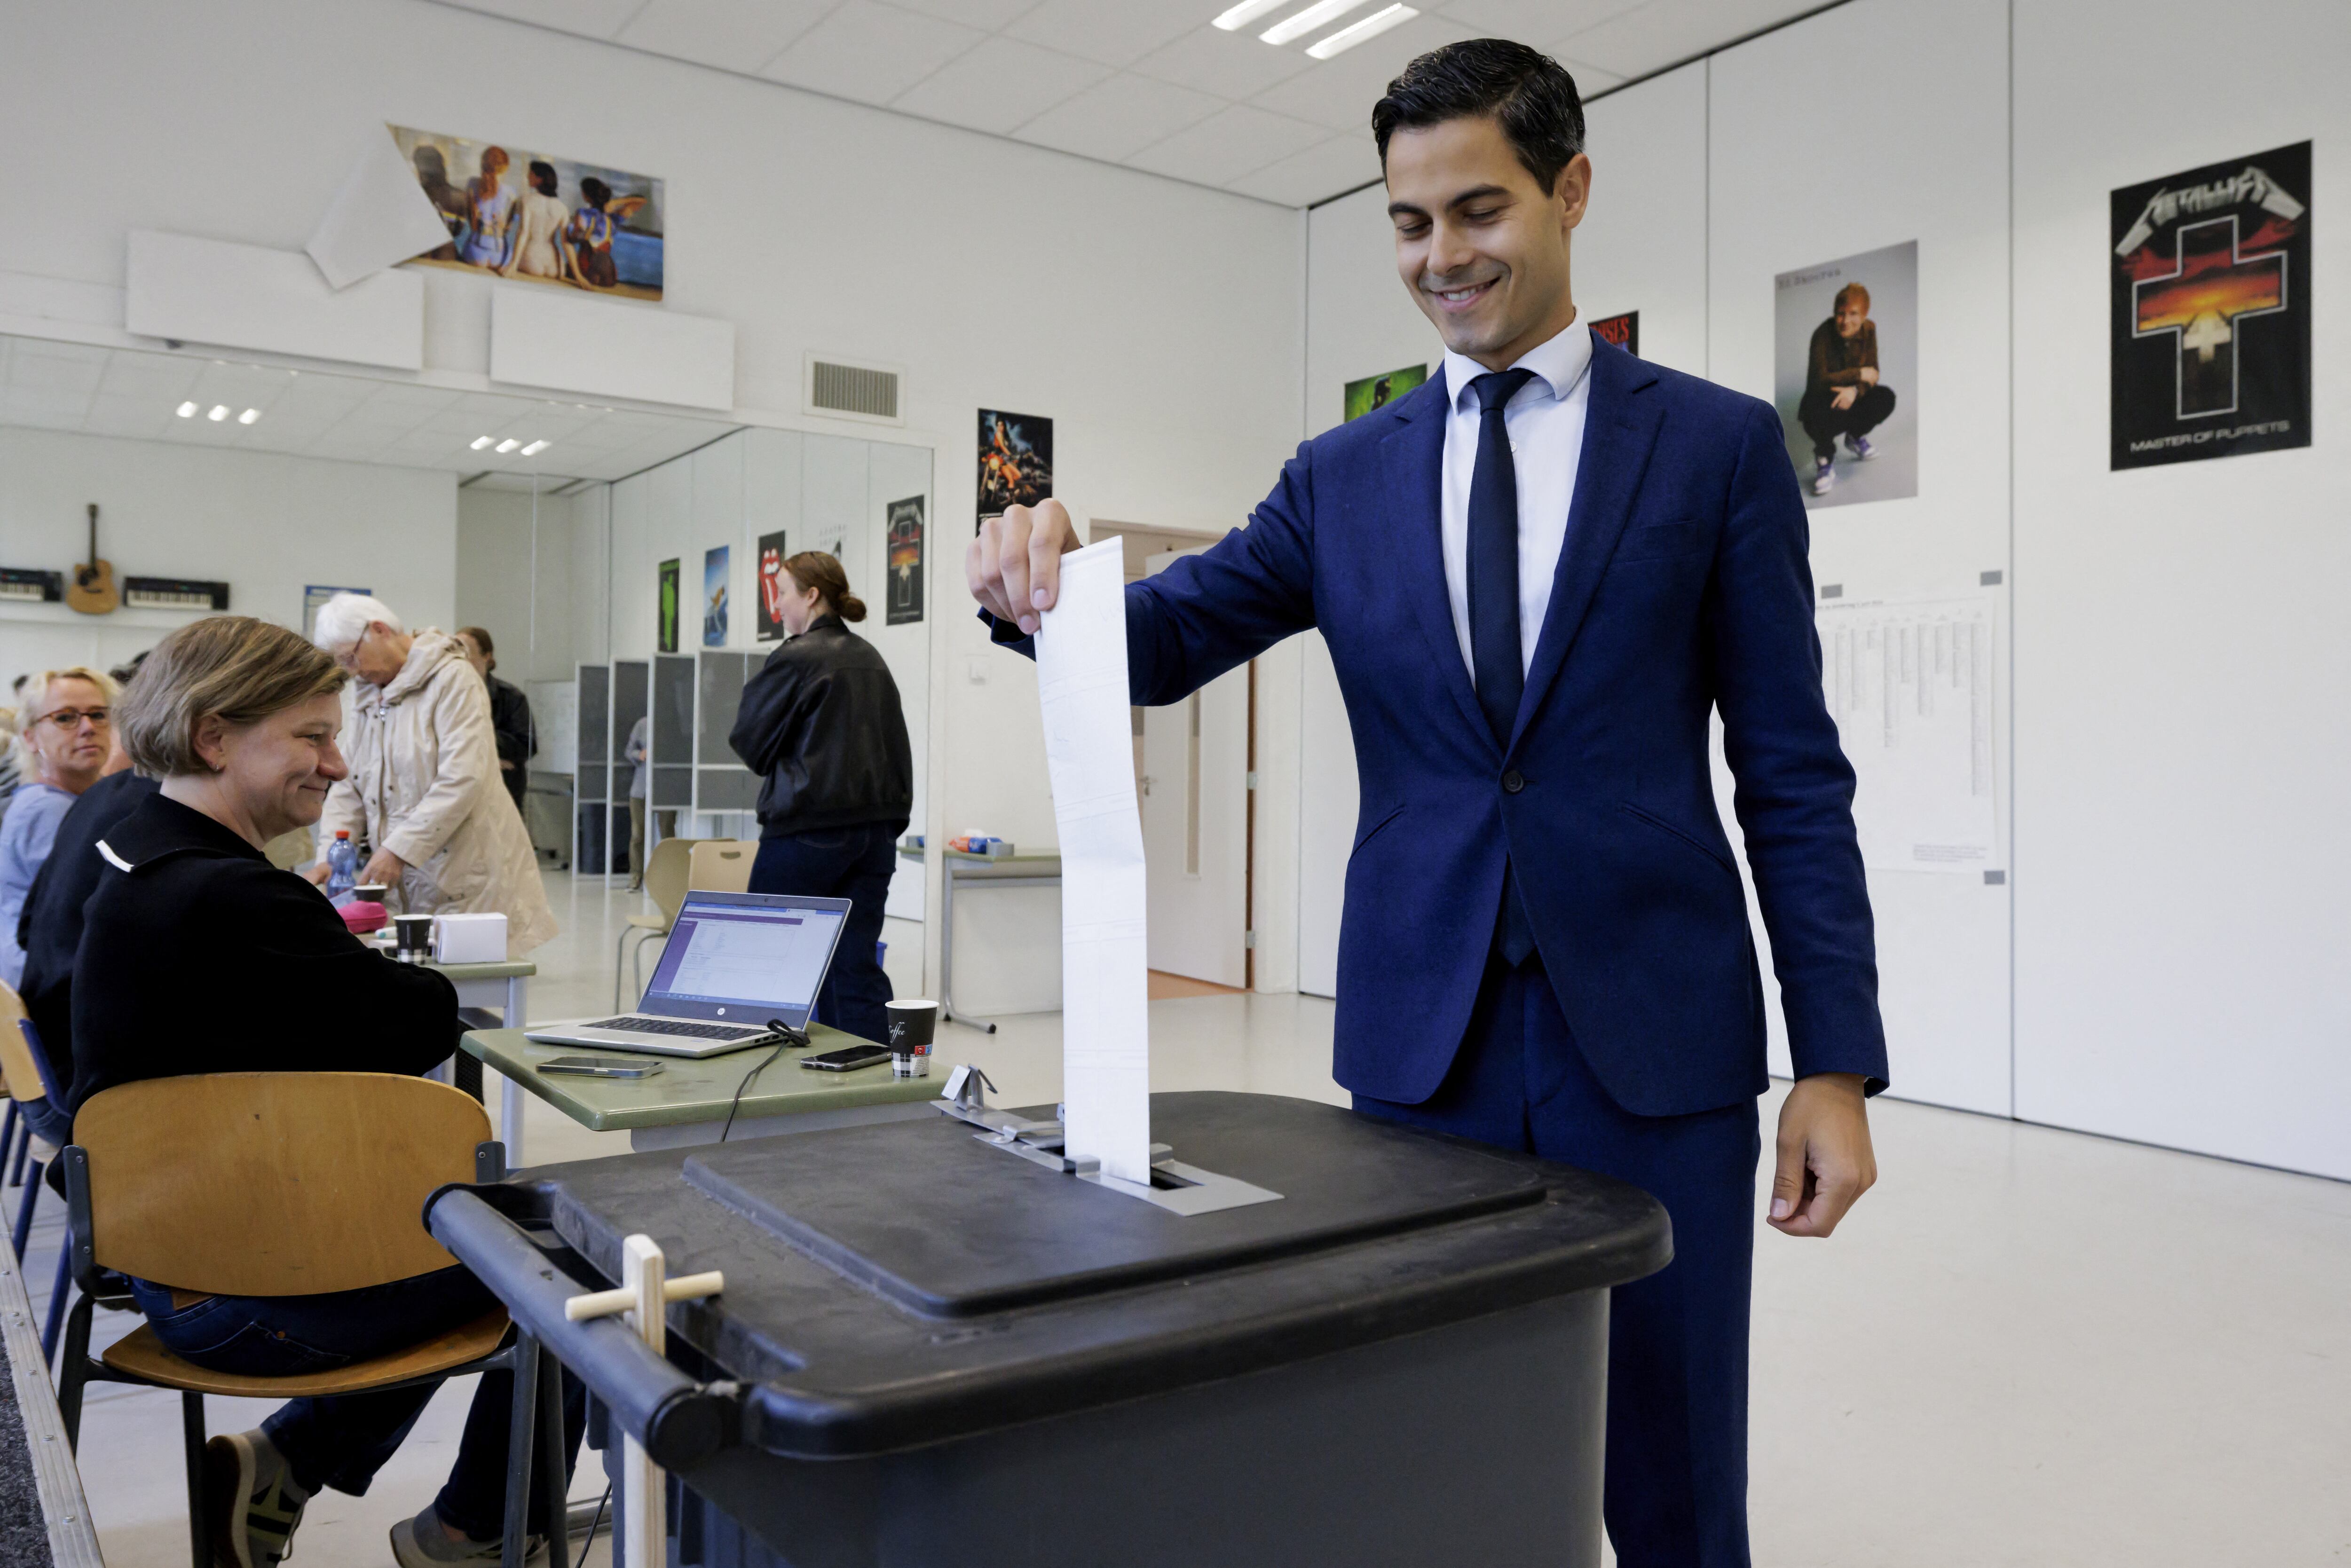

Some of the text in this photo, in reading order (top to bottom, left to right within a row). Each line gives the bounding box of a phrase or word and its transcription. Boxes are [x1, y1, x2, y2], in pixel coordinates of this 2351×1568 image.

[2130, 420, 2290, 452] MASTER OF PUPPETS
